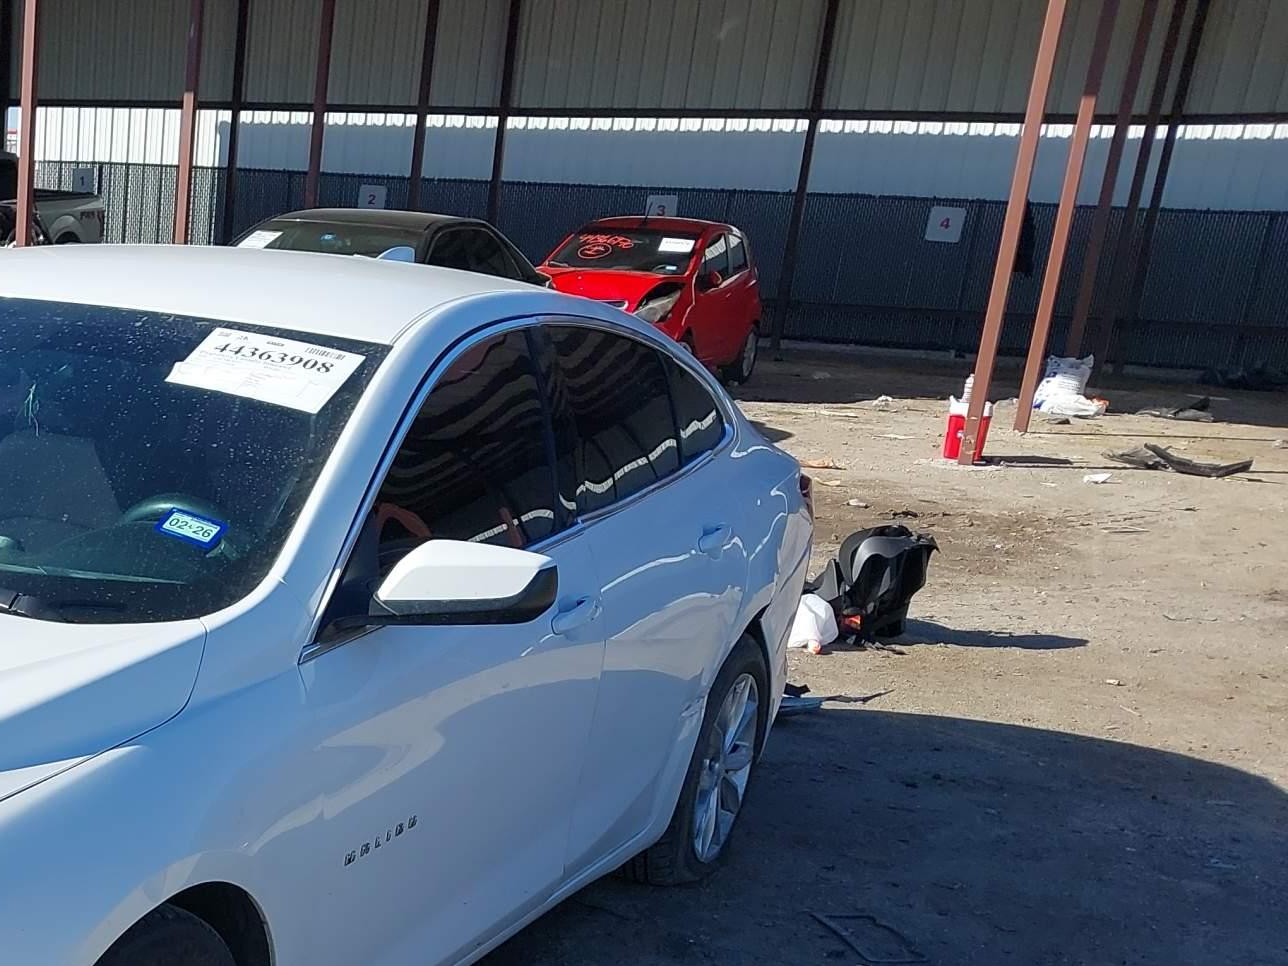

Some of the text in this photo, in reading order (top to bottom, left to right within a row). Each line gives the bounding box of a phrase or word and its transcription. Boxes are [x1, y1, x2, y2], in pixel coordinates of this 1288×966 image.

[367, 193, 377, 205] 2
[656, 204, 667, 217] 3
[940, 217, 951, 230] 4
[214, 342, 335, 375] 44363908
[343, 814, 418, 867] MALIBU
